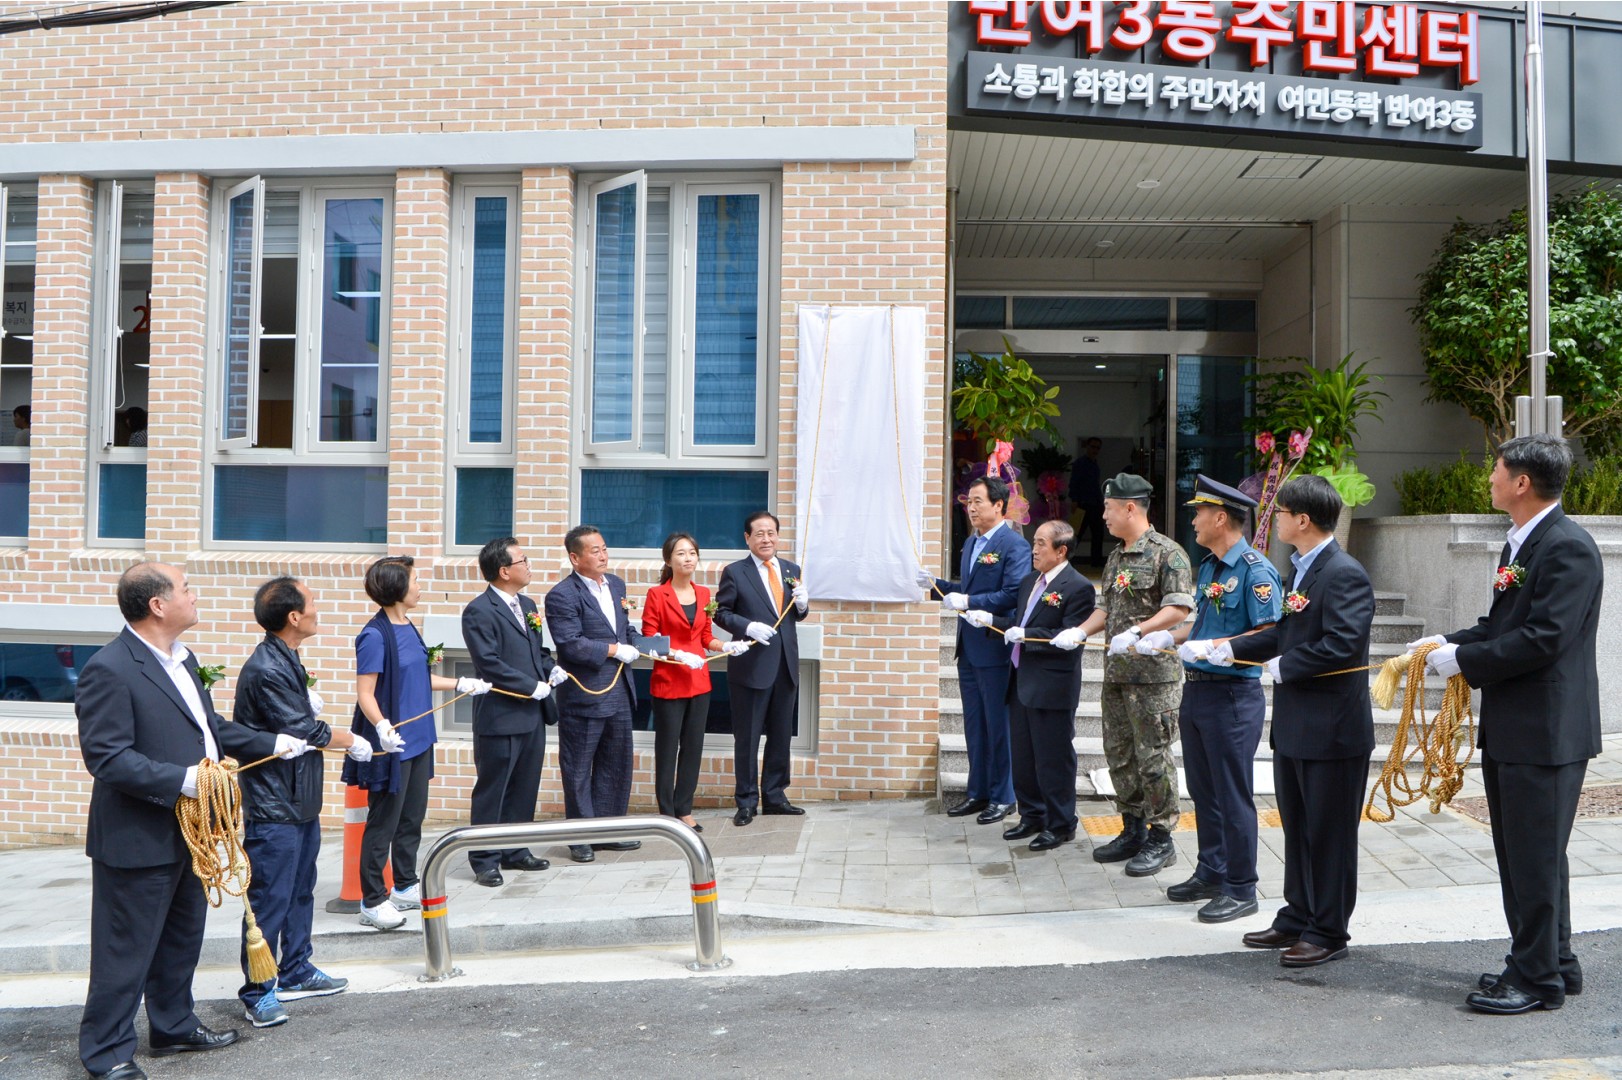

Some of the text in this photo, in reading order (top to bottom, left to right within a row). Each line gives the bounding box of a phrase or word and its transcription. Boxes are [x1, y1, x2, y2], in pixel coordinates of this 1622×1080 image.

[984, 63, 1476, 133] 소통과 화합의 주민자치 여민동락 반여3동
[5, 301, 27, 314] 복지
